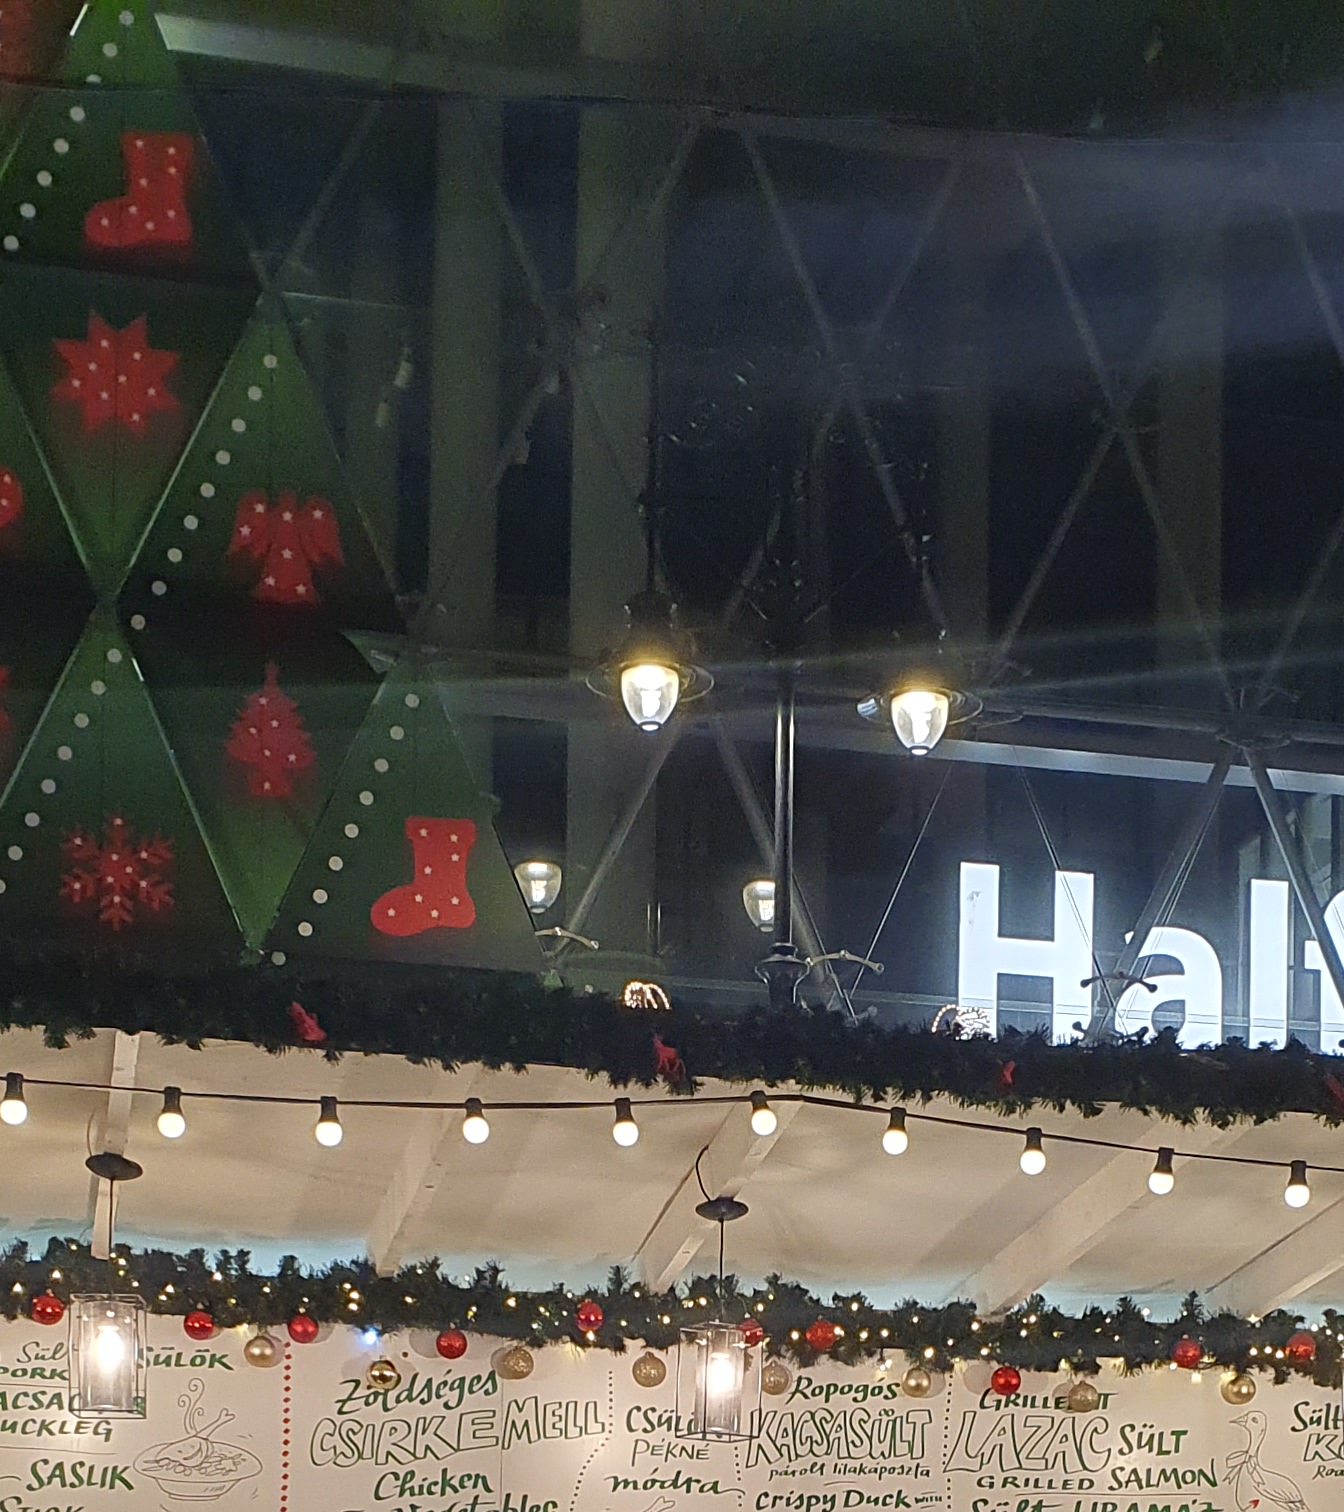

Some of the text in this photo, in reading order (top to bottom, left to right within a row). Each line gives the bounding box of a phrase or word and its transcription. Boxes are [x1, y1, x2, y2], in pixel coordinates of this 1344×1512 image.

[785, 1375, 900, 1405] Ropogós
[1291, 1401, 1343, 1432] Sült
[631, 1438, 710, 1467] PÉKNÉ
[745, 1407, 932, 1468] KACSASÜLT
[943, 1410, 1189, 1475] LAZAC SÜLT
[26, 1459, 135, 1491] SASLIK
[374, 1467, 494, 1501] Chicken
[605, 1467, 746, 1494] módra
[768, 1461, 930, 1481] párolt lilakáposzta
[976, 1458, 1218, 1491] GRILLED SALMON
[843, 1489, 912, 1509] Duck
